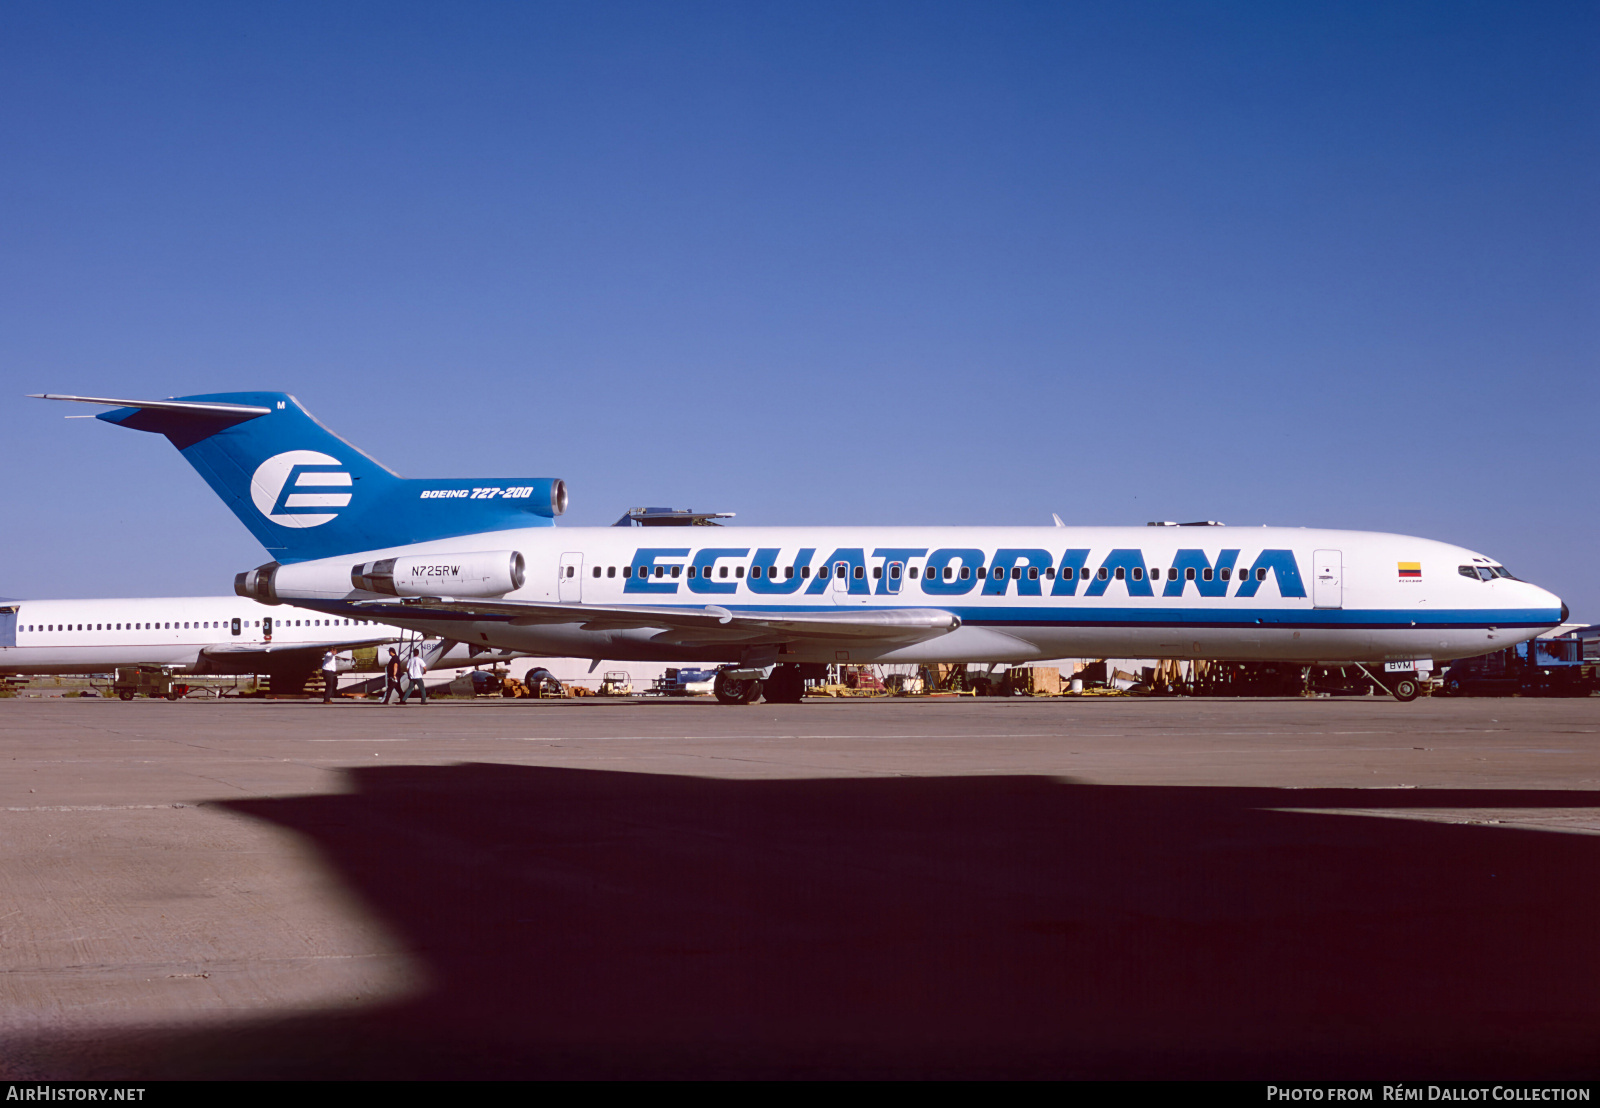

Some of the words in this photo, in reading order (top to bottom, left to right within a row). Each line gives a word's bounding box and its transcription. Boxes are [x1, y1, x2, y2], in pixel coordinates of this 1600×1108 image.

[277, 401, 286, 410] M
[420, 490, 469, 499] BOEING
[470, 487, 534, 499] 727-200
[412, 565, 460, 577] N725RW
[623, 548, 1307, 598] ECUATORIANA
[1389, 661, 1411, 670] BVM
